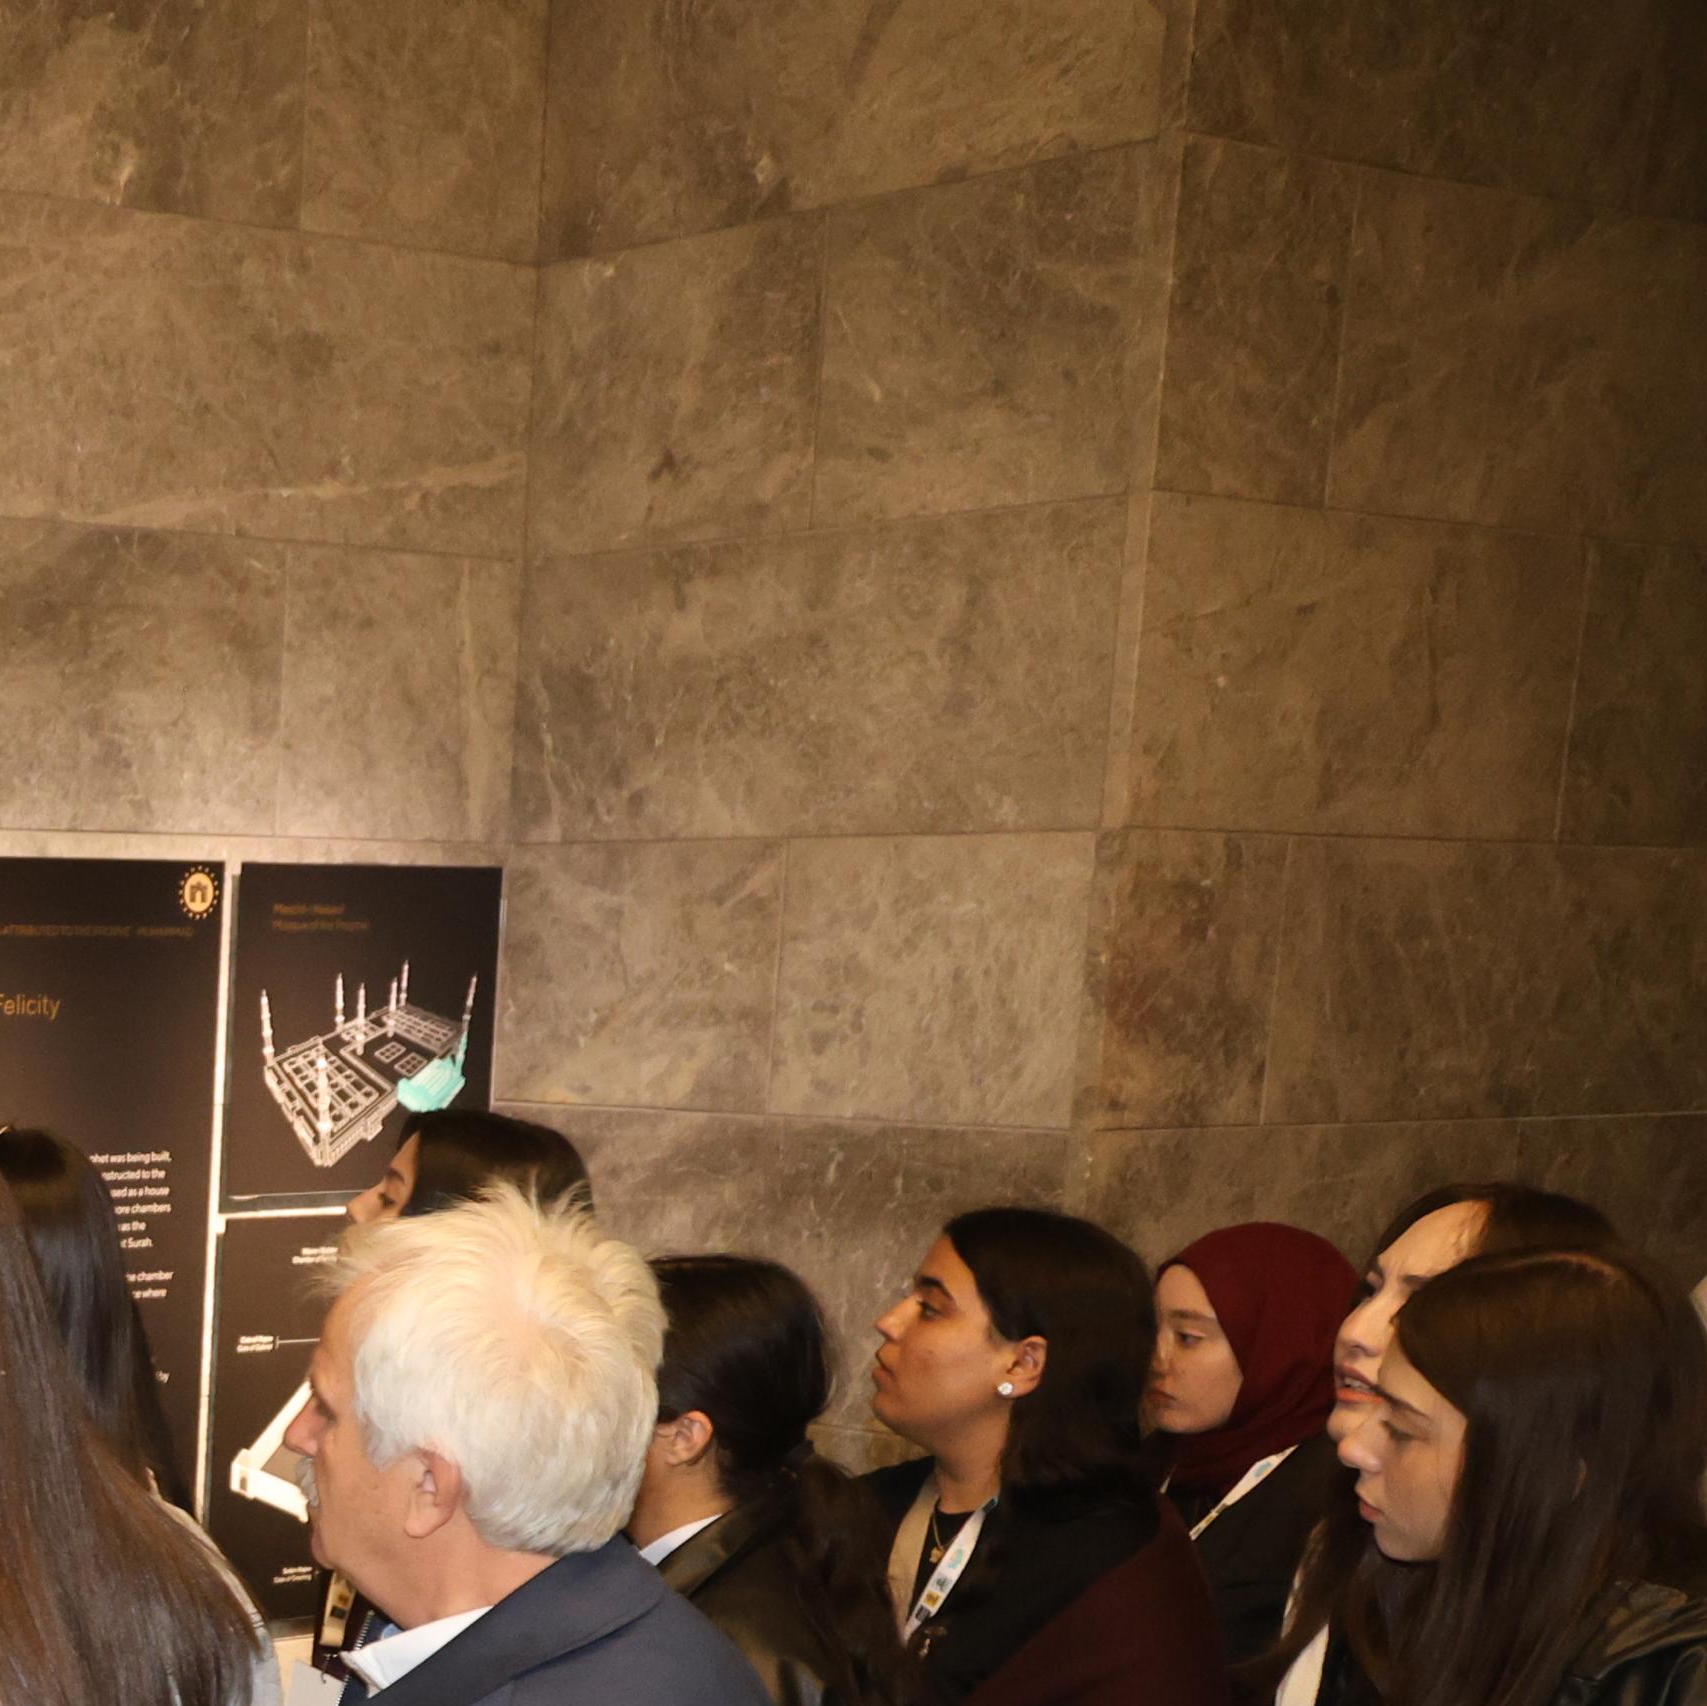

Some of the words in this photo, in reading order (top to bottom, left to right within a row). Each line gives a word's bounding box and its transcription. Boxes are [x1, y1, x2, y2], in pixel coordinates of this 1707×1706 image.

[127, 1153, 151, 1164] being
[141, 1170, 151, 1180] to
[151, 1169, 166, 1179] the
[131, 1203, 172, 1213] chambers
[142, 1289, 167, 1298] where
